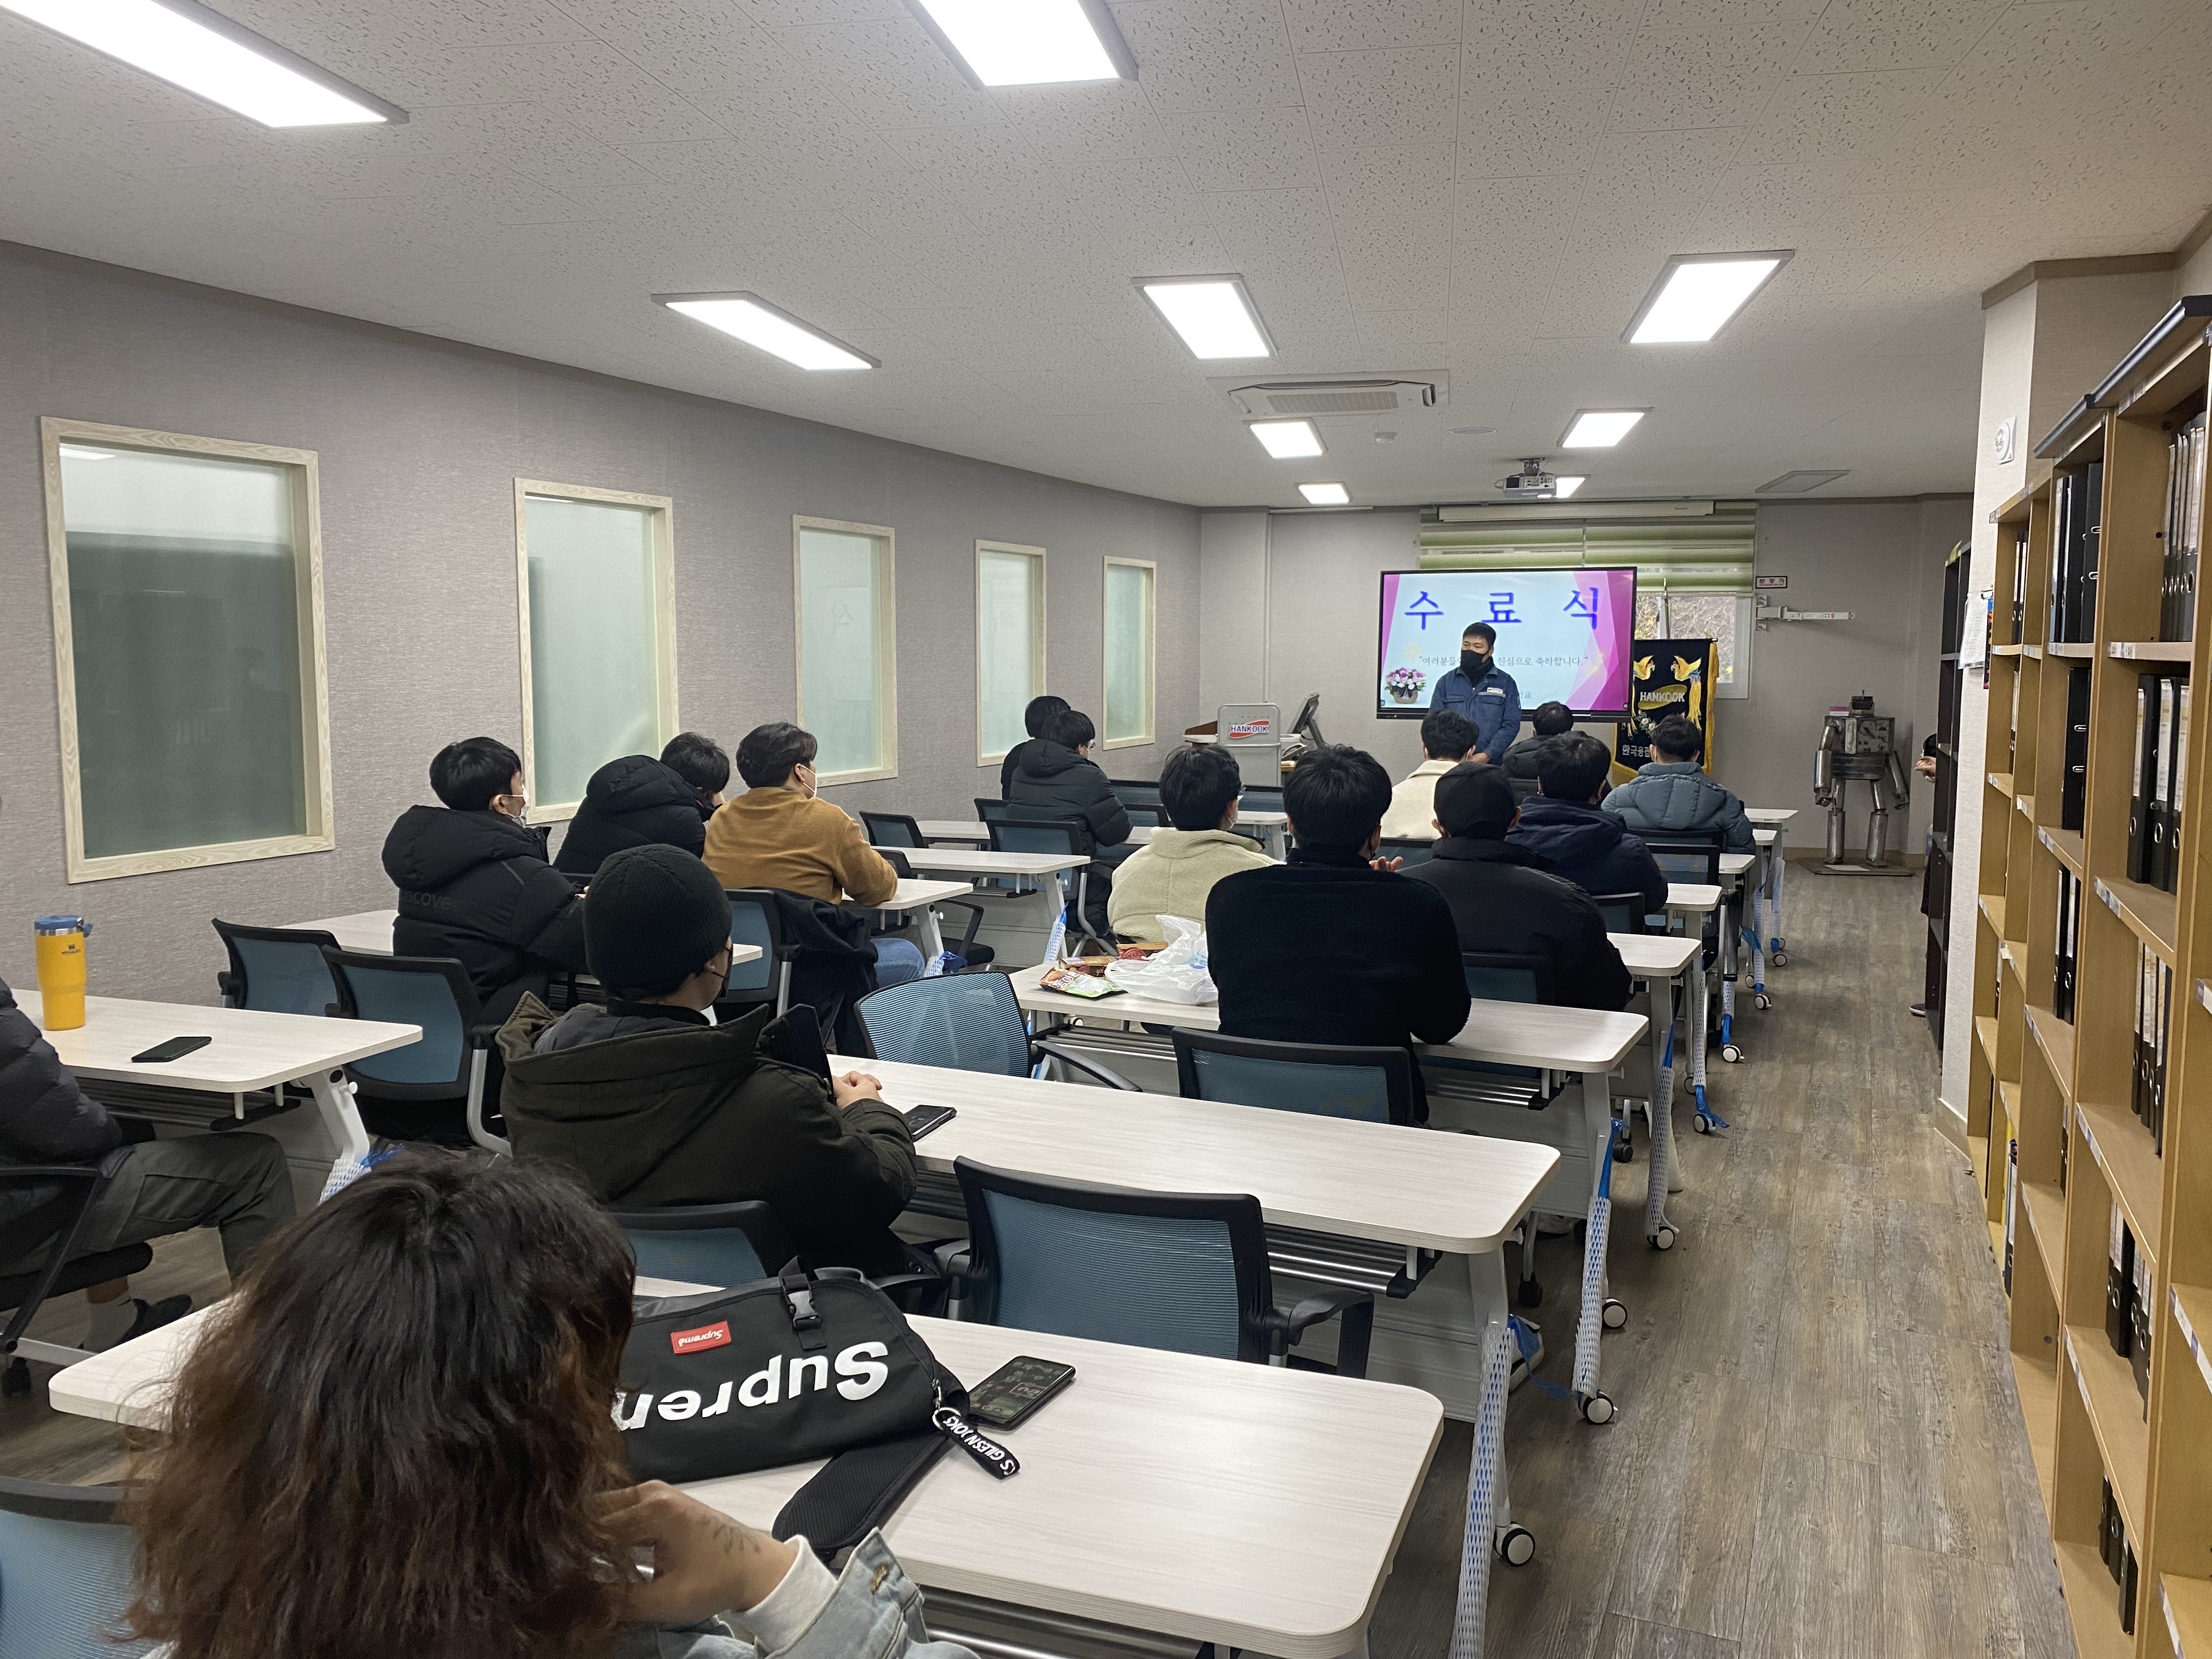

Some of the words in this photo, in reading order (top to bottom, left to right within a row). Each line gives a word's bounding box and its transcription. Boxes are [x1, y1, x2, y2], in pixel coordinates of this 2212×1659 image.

[1404, 591, 1444, 630] 수
[1481, 591, 1522, 624] 료
[1563, 587, 1598, 630] 식
[1497, 657, 1533, 667] 진심으로
[1640, 691, 1685, 702] HANKOOK
